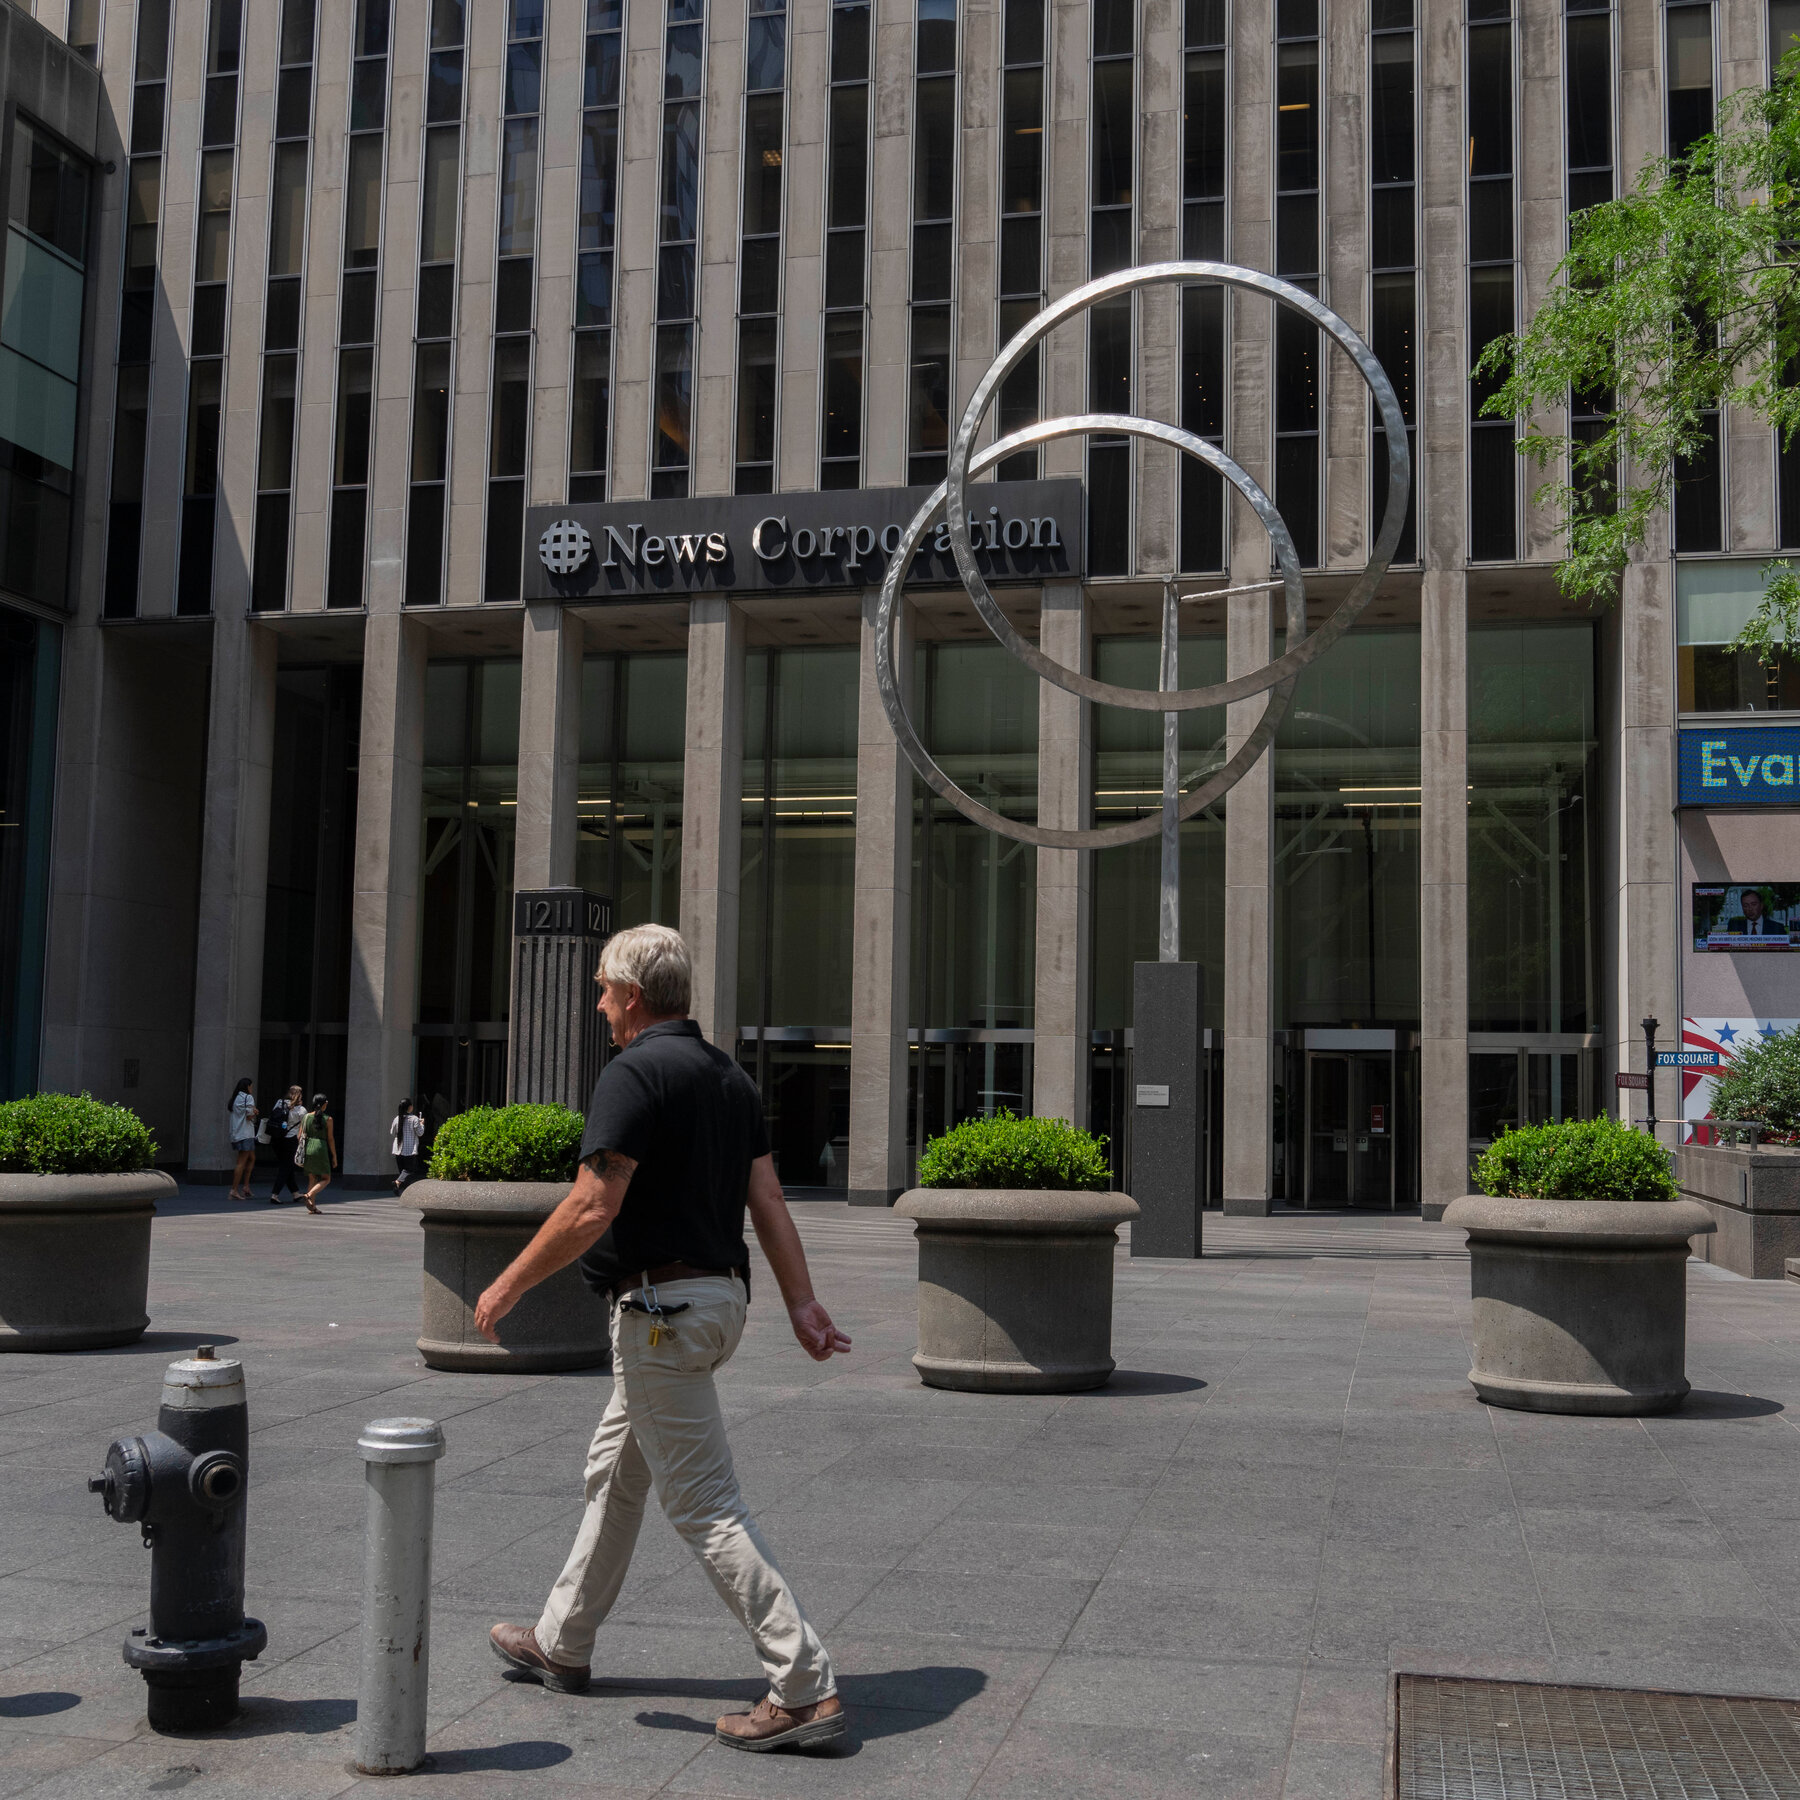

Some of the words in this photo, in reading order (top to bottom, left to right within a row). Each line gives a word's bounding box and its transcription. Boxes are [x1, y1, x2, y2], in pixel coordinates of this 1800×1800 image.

[602, 523, 728, 566] News
[752, 506, 1061, 568] Corpoation
[1701, 741, 1800, 787] Eva
[524, 900, 573, 929] 1211
[587, 902, 610, 934] 1211
[1657, 1053, 1676, 1065] FOX
[1677, 1053, 1715, 1065] SQUARE
[1617, 1075, 1628, 1086] FOX
[1628, 1075, 1648, 1087] SQUARE
